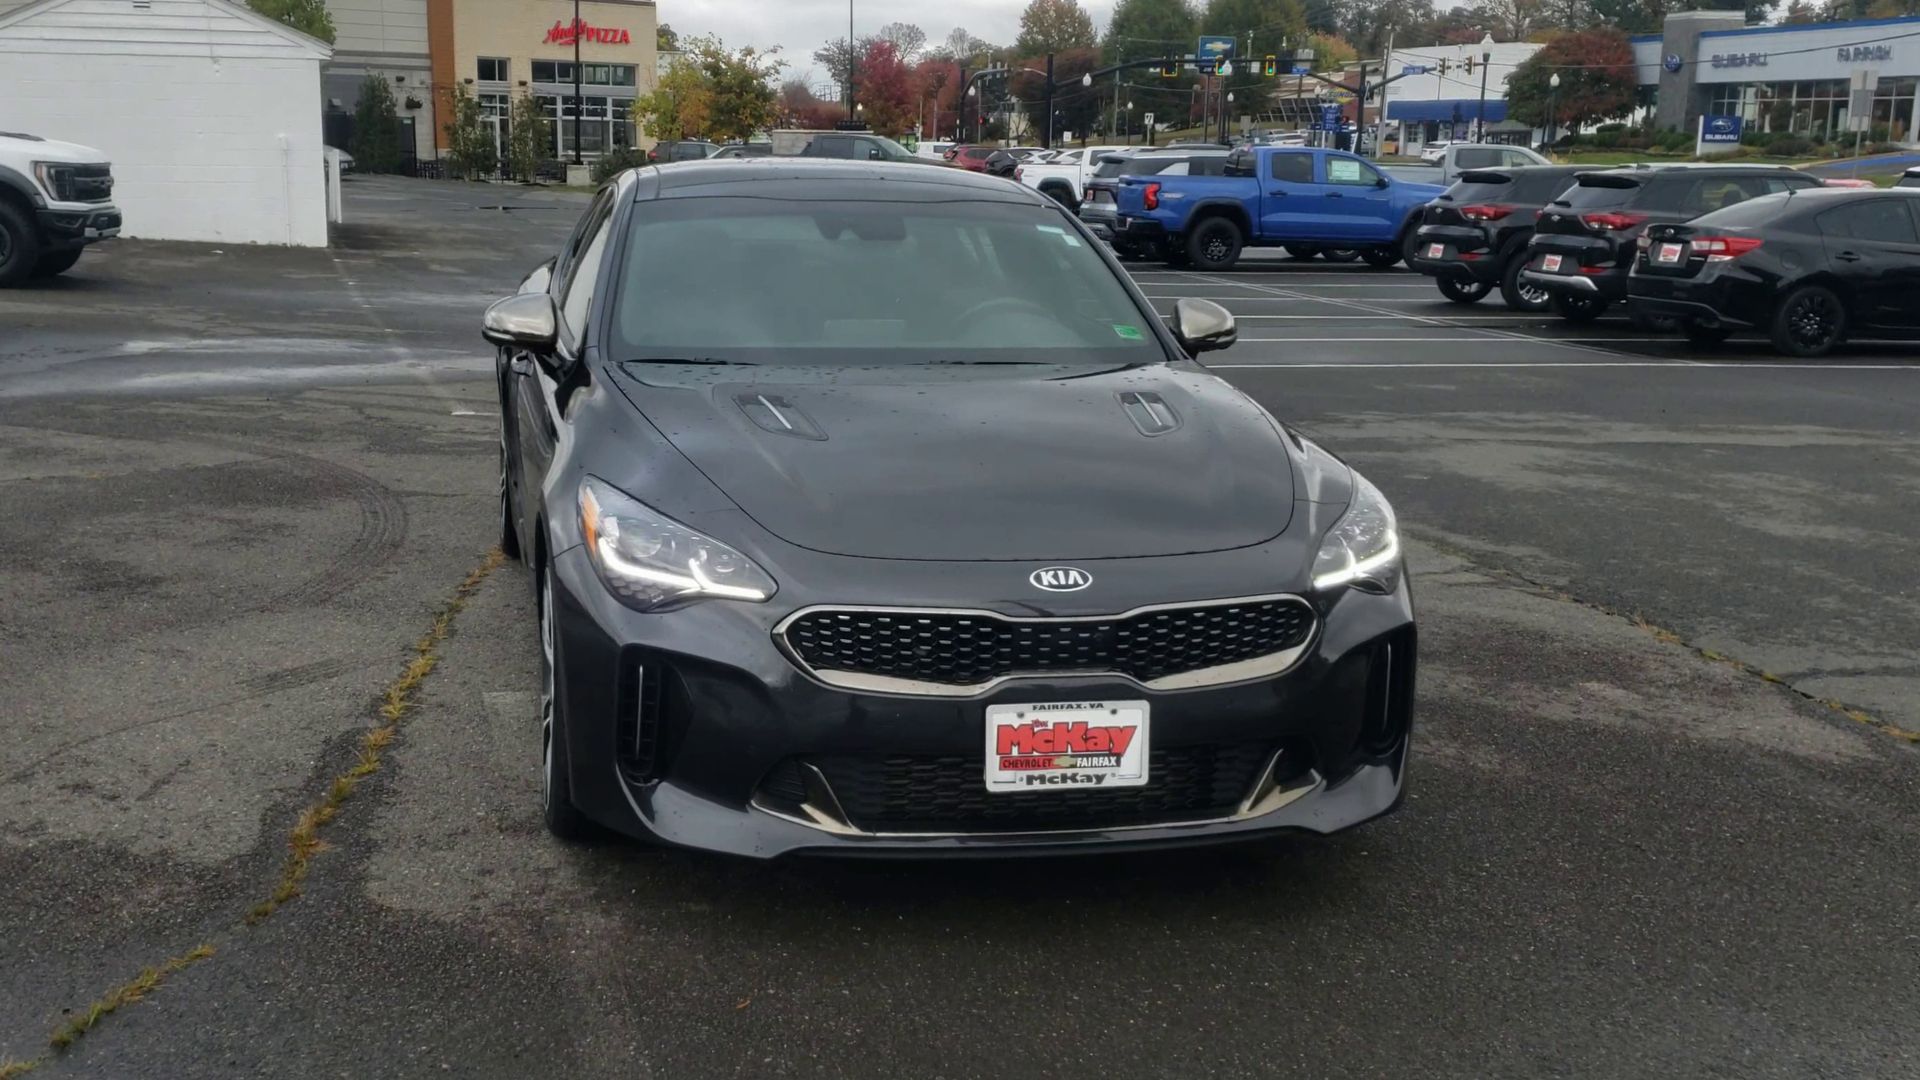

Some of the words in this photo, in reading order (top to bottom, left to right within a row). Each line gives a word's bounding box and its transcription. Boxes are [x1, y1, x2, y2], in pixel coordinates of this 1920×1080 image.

[587, 27, 630, 44] PIZZA
[1711, 52, 1769, 69] SUBARU
[1704, 133, 1738, 141] SUBARU
[1040, 570, 1084, 585] KIA
[997, 721, 1137, 757] McKay
[1002, 758, 1053, 768] CHEVROLET
[1076, 756, 1117, 767] FAIRFAX
[1026, 772, 1108, 785] McKay
